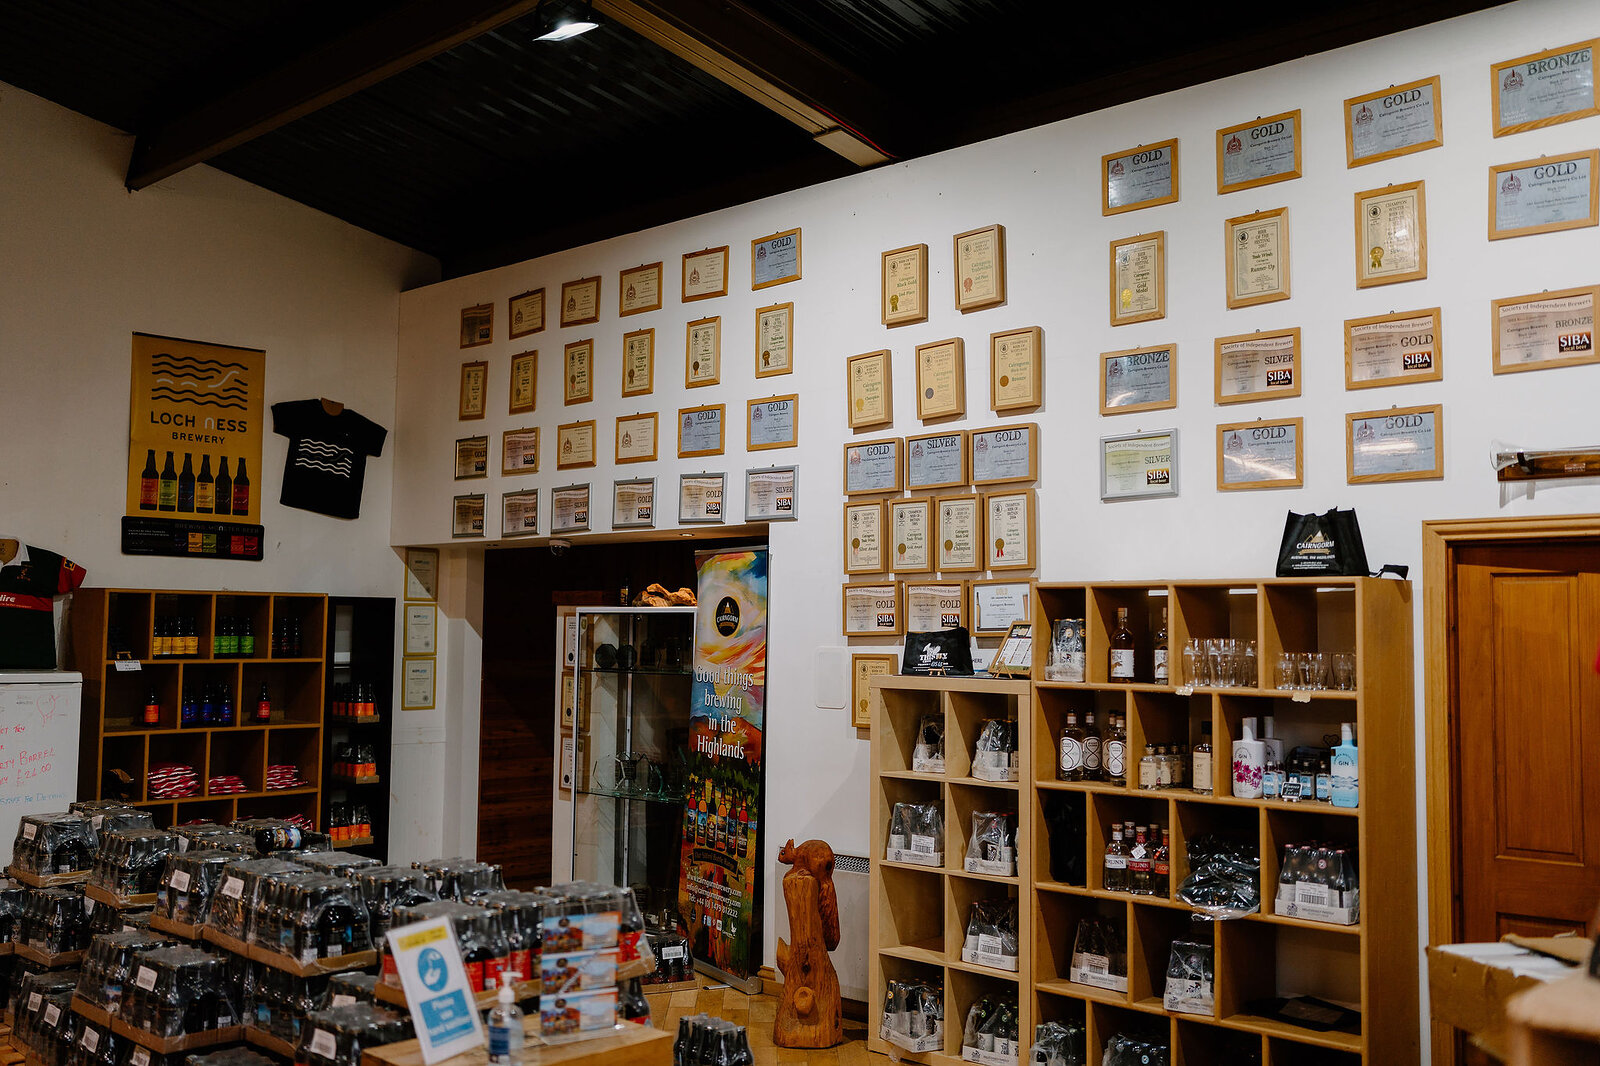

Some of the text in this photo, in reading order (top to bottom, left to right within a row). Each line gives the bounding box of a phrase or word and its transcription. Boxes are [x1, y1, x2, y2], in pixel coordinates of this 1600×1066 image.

[1527, 50, 1590, 76] BRONZE
[1384, 89, 1421, 109] GOLD
[1251, 123, 1284, 140] GOLD
[1132, 149, 1163, 166] GOLD
[1534, 162, 1577, 180] GOLD
[771, 237, 791, 250] GOLD
[1250, 264, 1275, 273] Runner-Up
[1501, 305, 1522, 313] Society
[1530, 302, 1566, 310] Independent
[1568, 299, 1591, 307] Brewers
[1354, 324, 1372, 332] Society
[1555, 316, 1593, 329] BRONZE
[1401, 334, 1433, 347] GOLD
[1560, 333, 1589, 348] SIBA
[1128, 351, 1170, 366] BRONZE
[1264, 354, 1294, 365] SILVER
[1404, 353, 1430, 365] SIBA
[1268, 370, 1291, 382] SIBA
[768, 401, 788, 412] GOLD
[150, 410, 196, 428] LOCH
[697, 410, 716, 421] GOLD
[1385, 415, 1423, 430] GOLD
[172, 432, 225, 444] BREWERY
[995, 430, 1022, 442] GOLD
[1252, 427, 1286, 440] GOLD
[927, 436, 957, 449] SILVER
[867, 445, 889, 456] GOLD
[1144, 454, 1171, 464] SILVER
[1148, 470, 1168, 480] SIBA
[706, 490, 722, 498] GOLD
[775, 486, 793, 494] SILVER
[637, 495, 652, 504] GOLD
[777, 498, 791, 507] SIBA
[707, 503, 720, 511] SIBA
[1296, 540, 1335, 549] CAIRNGORM
[876, 600, 895, 609] GOLD
[940, 600, 961, 608] GOLD
[716, 613, 739, 624] CAIRNGORM
[878, 614, 894, 623] SIBA
[942, 614, 959, 623] SIBA
[696, 664, 754, 691] Good things
[704, 688, 742, 714] brewing
[708, 712, 737, 734] in the
[697, 735, 744, 760] Highlands
[20, 747, 55, 766] BARREL
[687, 873, 742, 898] www.cairngormbrewery.com
[686, 882, 741, 908] info@cairngormbrewery.com
[711, 901, 722, 912] 1479
[722, 906, 738, 918] 812222
